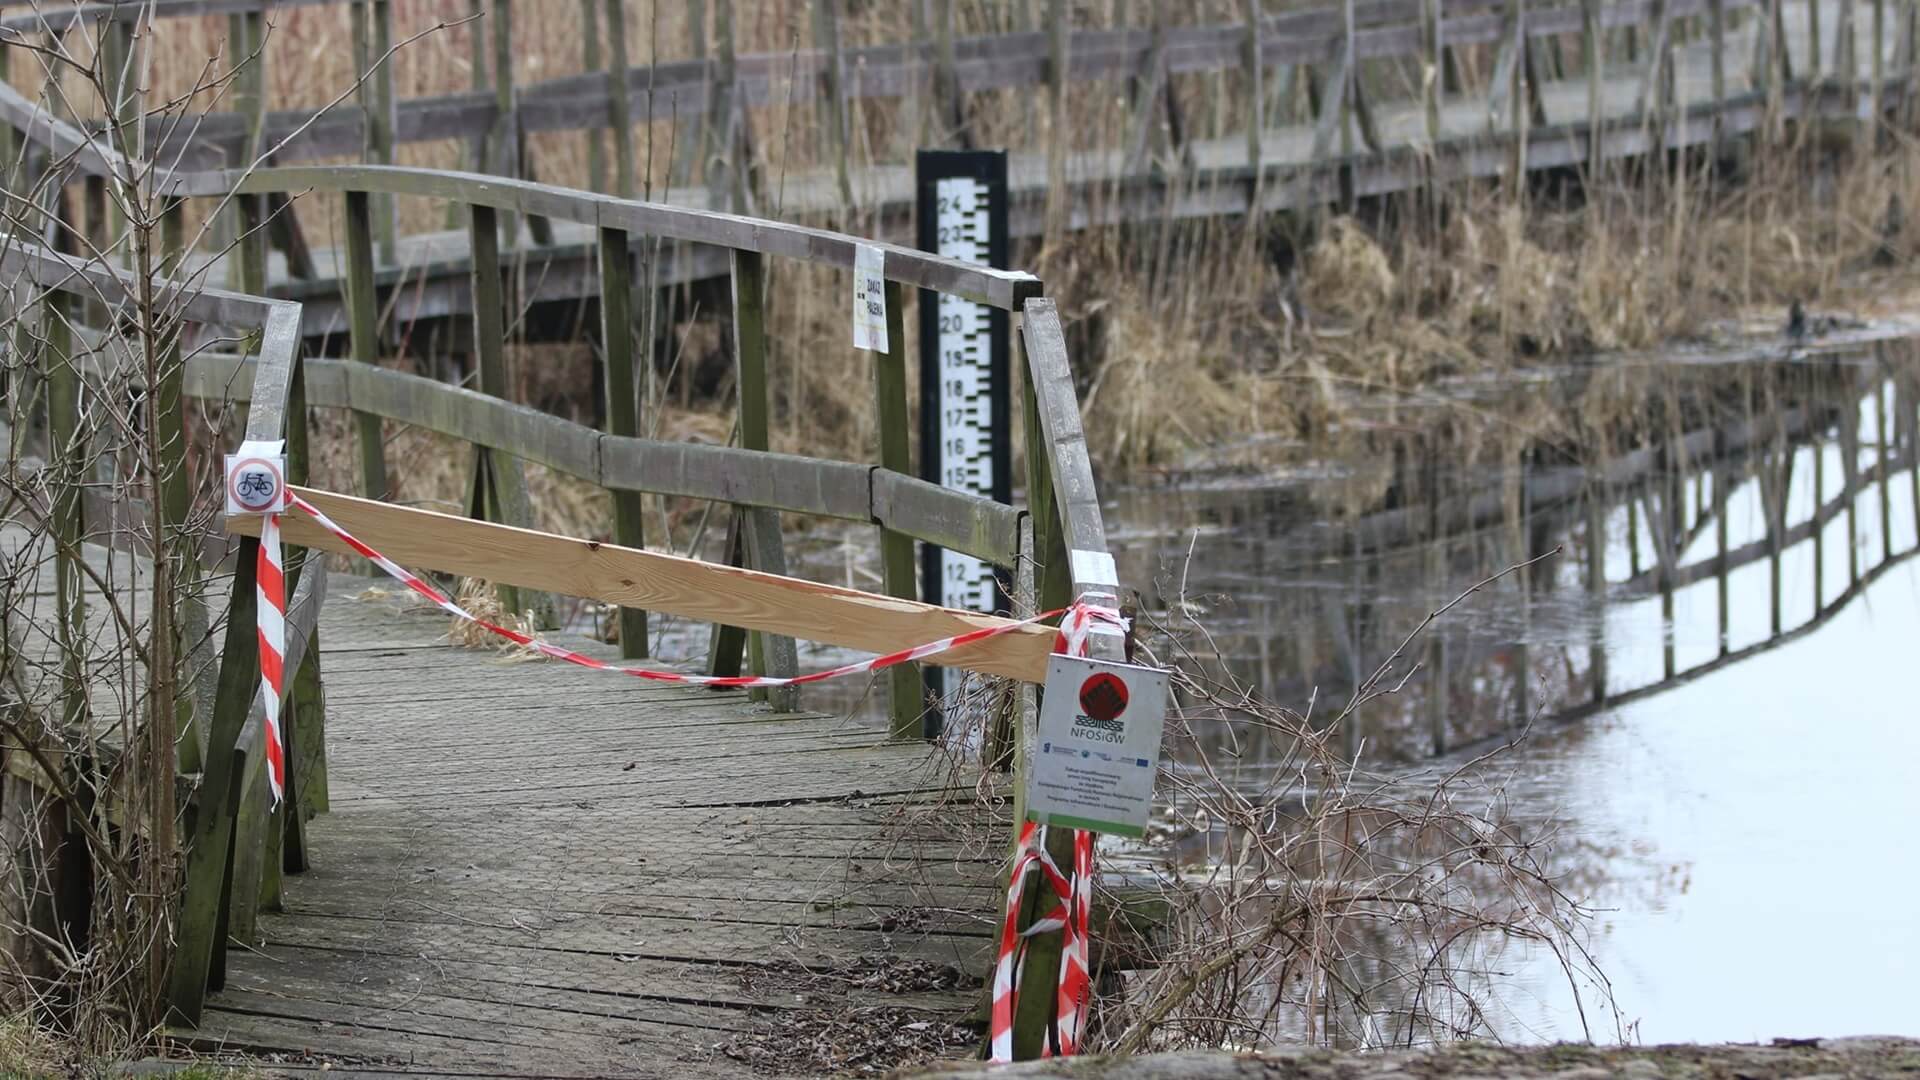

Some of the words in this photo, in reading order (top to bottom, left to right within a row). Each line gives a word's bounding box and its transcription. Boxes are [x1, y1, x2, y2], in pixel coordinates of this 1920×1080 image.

[939, 196, 961, 214] 24
[939, 225, 961, 244] 23
[940, 314, 962, 334] 20
[946, 351, 963, 368] 19
[946, 380, 963, 398] 18
[946, 409, 962, 428] 17
[947, 438, 965, 457] 16
[947, 467, 966, 487] 15
[948, 564, 965, 581] 12
